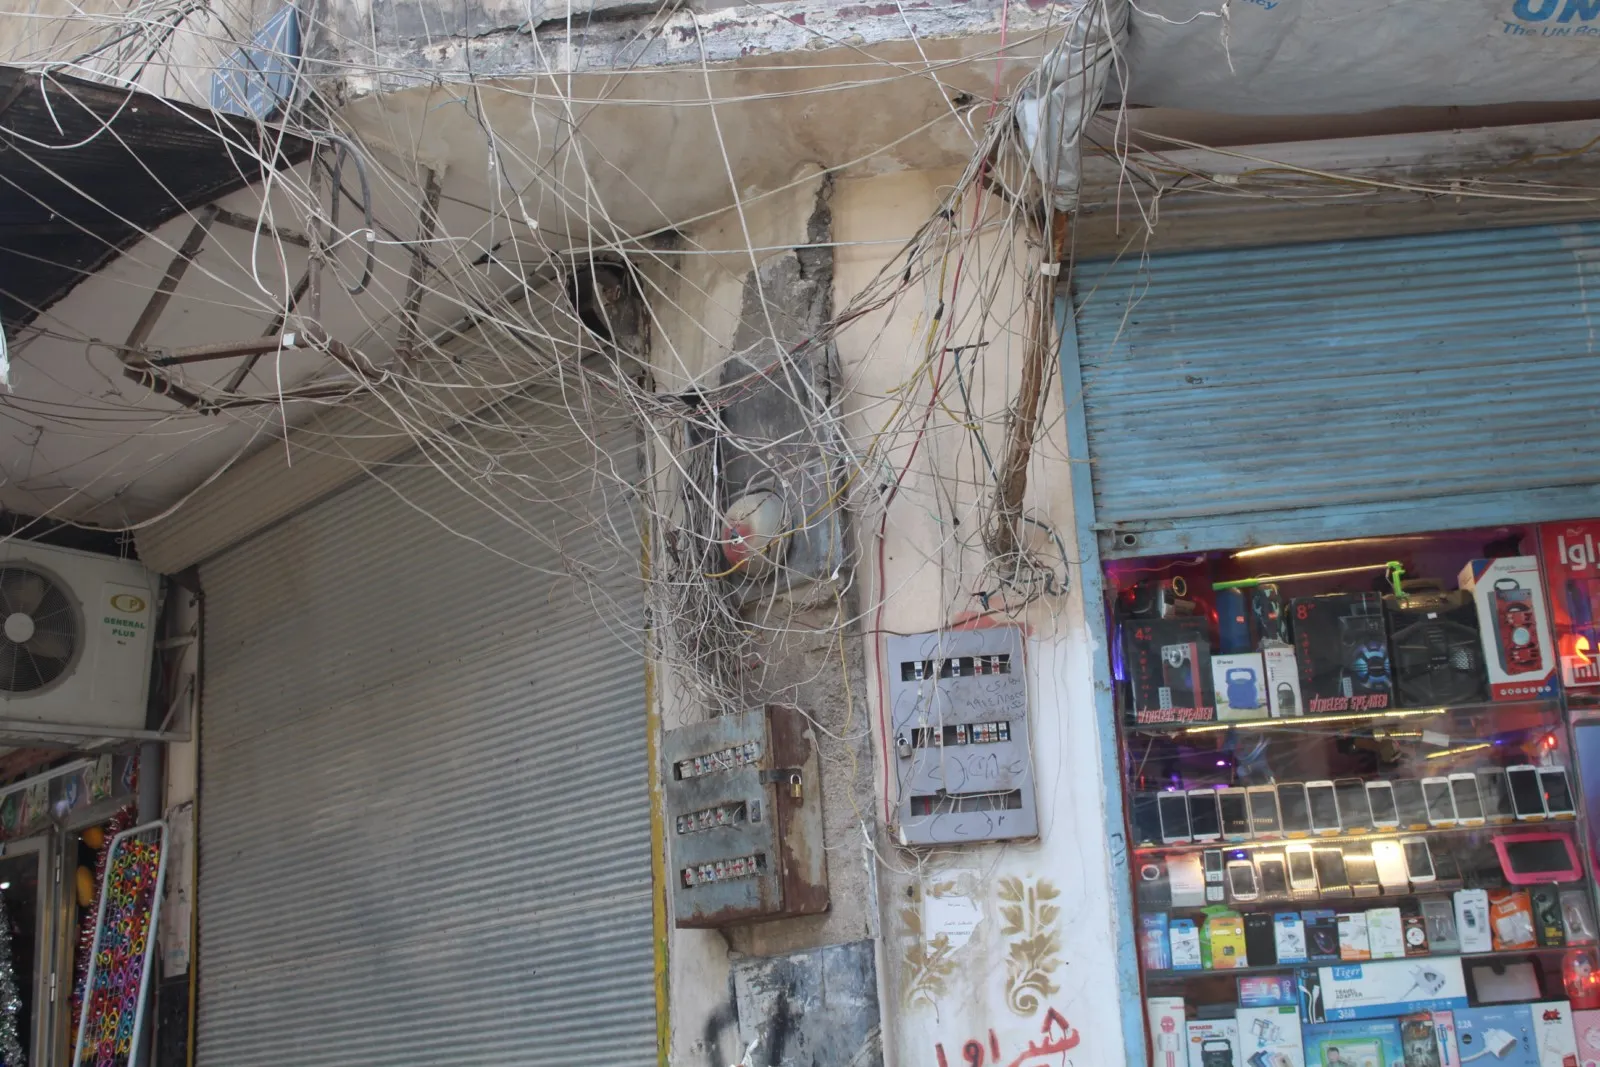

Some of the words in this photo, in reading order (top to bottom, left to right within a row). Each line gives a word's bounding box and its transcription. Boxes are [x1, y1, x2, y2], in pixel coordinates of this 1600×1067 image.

[1503, 21, 1537, 36] The
[1542, 26, 1571, 38] UN
[104, 617, 146, 629] GENERAL
[112, 629, 135, 637] PLUS
[1310, 693, 1348, 713] WIRELESS
[1351, 694, 1388, 712] SPEAKER
[1177, 707, 1213, 723] SPEAKER
[1334, 967, 1361, 980] Tiger
[1335, 987, 1356, 995] TRAVEL
